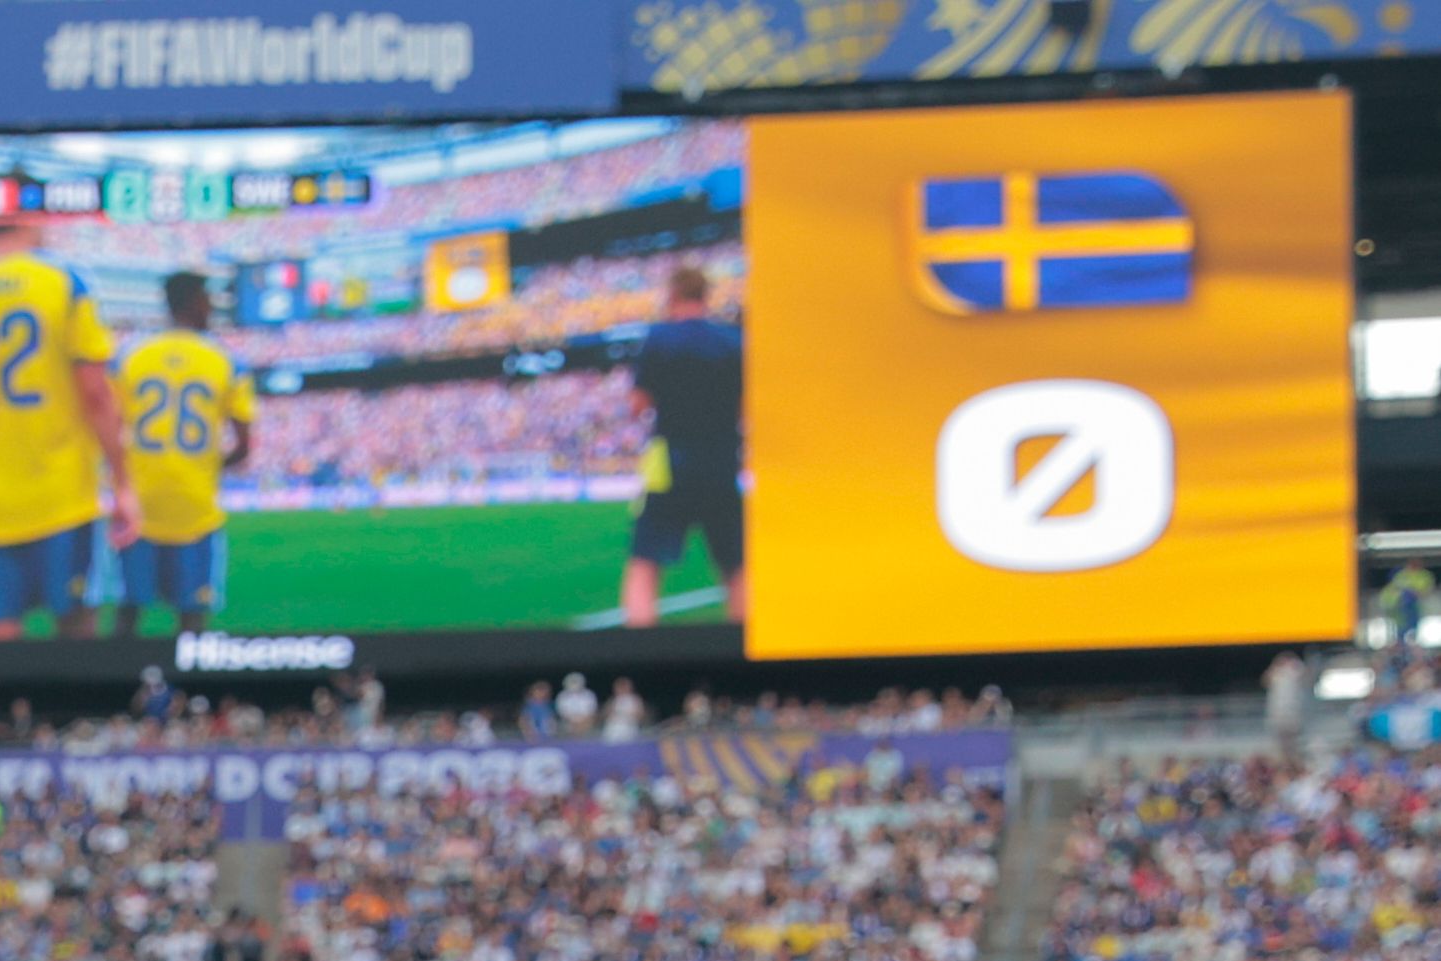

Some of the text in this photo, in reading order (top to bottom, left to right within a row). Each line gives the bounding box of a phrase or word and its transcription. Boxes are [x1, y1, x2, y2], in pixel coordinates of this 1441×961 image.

[45, 12, 472, 93] #FIFAWorldCup
[135, 378, 214, 454] 26
[935, 378, 1176, 573] 0
